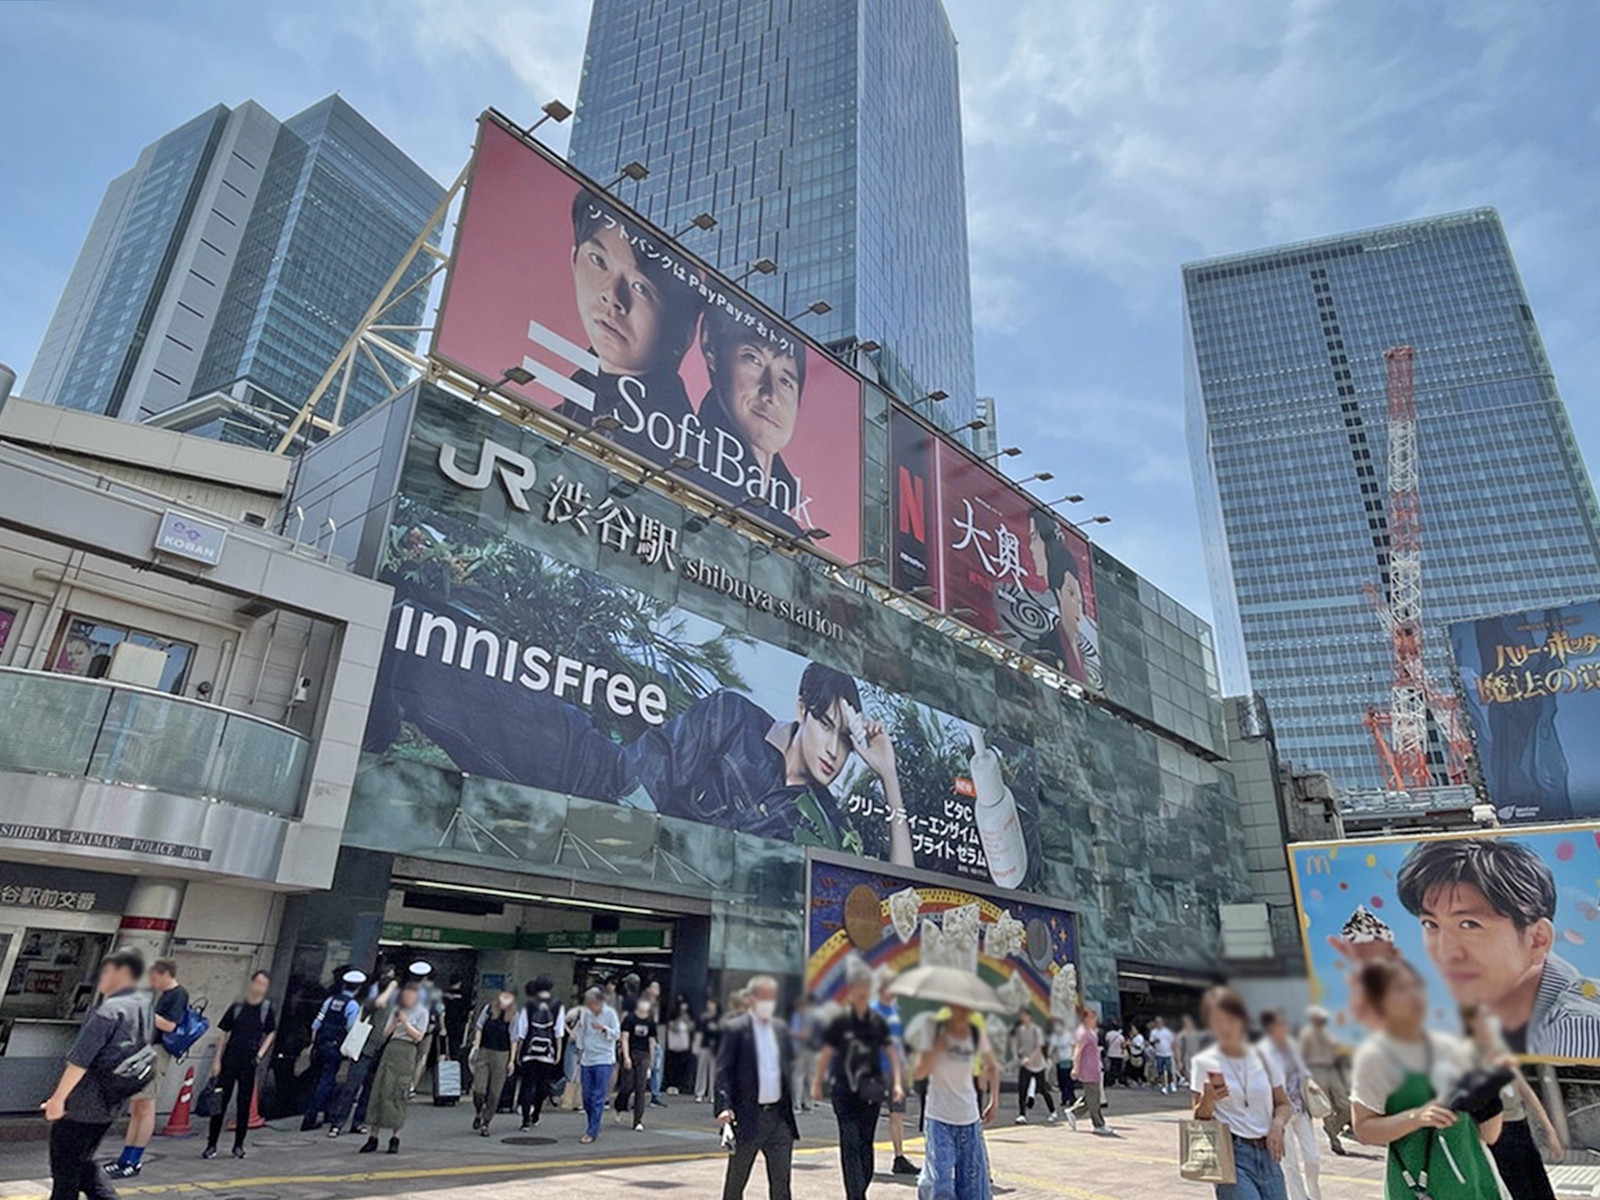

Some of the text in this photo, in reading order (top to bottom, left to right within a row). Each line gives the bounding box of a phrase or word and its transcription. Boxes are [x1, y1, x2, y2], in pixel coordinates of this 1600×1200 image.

[612, 376, 815, 530] SoftBank
[163, 534, 215, 559] KOBAN
[439, 438, 845, 641] JR 渋谷駅 shibuya station
[952, 498, 1028, 592] 大奥
[1496, 631, 1600, 673] ハリー・ポッタ
[0, 825, 204, 860] SHIBUYA-EKIMAE POLICE BOX
[0, 884, 96, 911] 谷駅前交番
